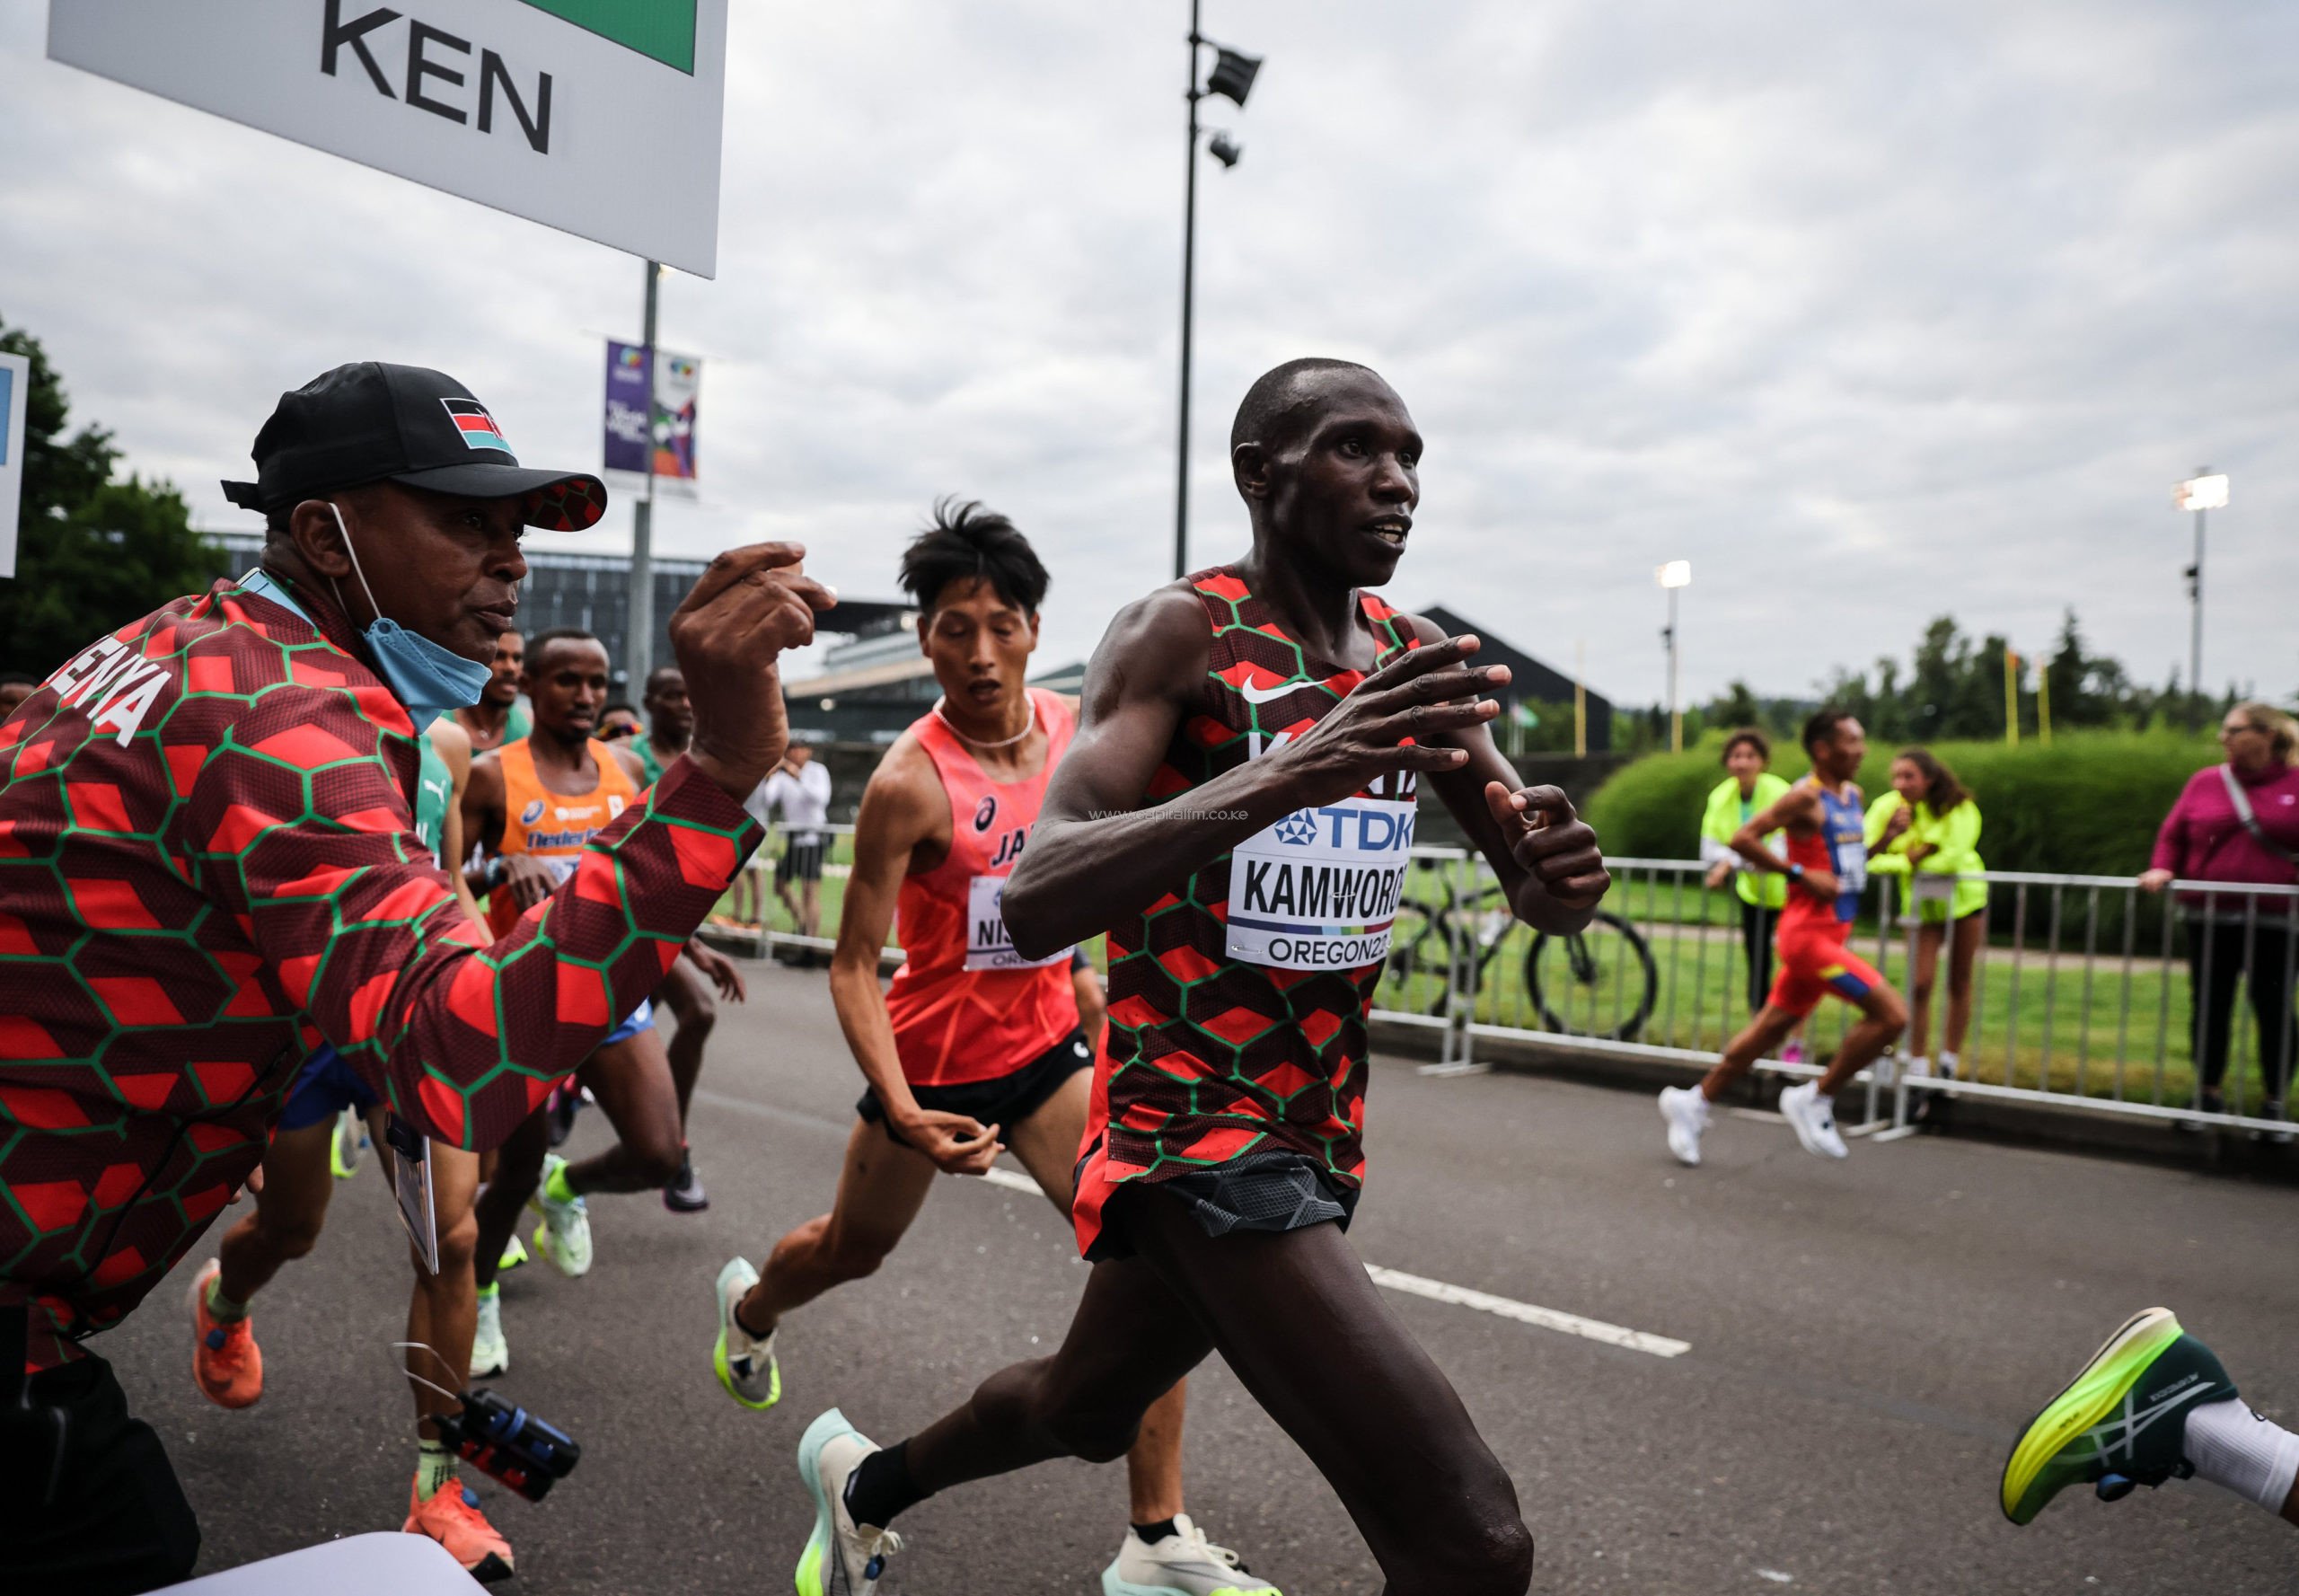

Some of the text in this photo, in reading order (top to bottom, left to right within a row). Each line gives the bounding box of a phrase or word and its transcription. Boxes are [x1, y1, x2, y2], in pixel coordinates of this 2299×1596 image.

[321, 0, 553, 155] KEN
[46, 634, 172, 748] ENYA
[991, 823, 1035, 867] JA
[1317, 807, 1416, 851] TDK
[1243, 860, 1408, 920] KAMWORO
[978, 919, 1012, 946] NI
[1268, 933, 1388, 966] OREGON22
